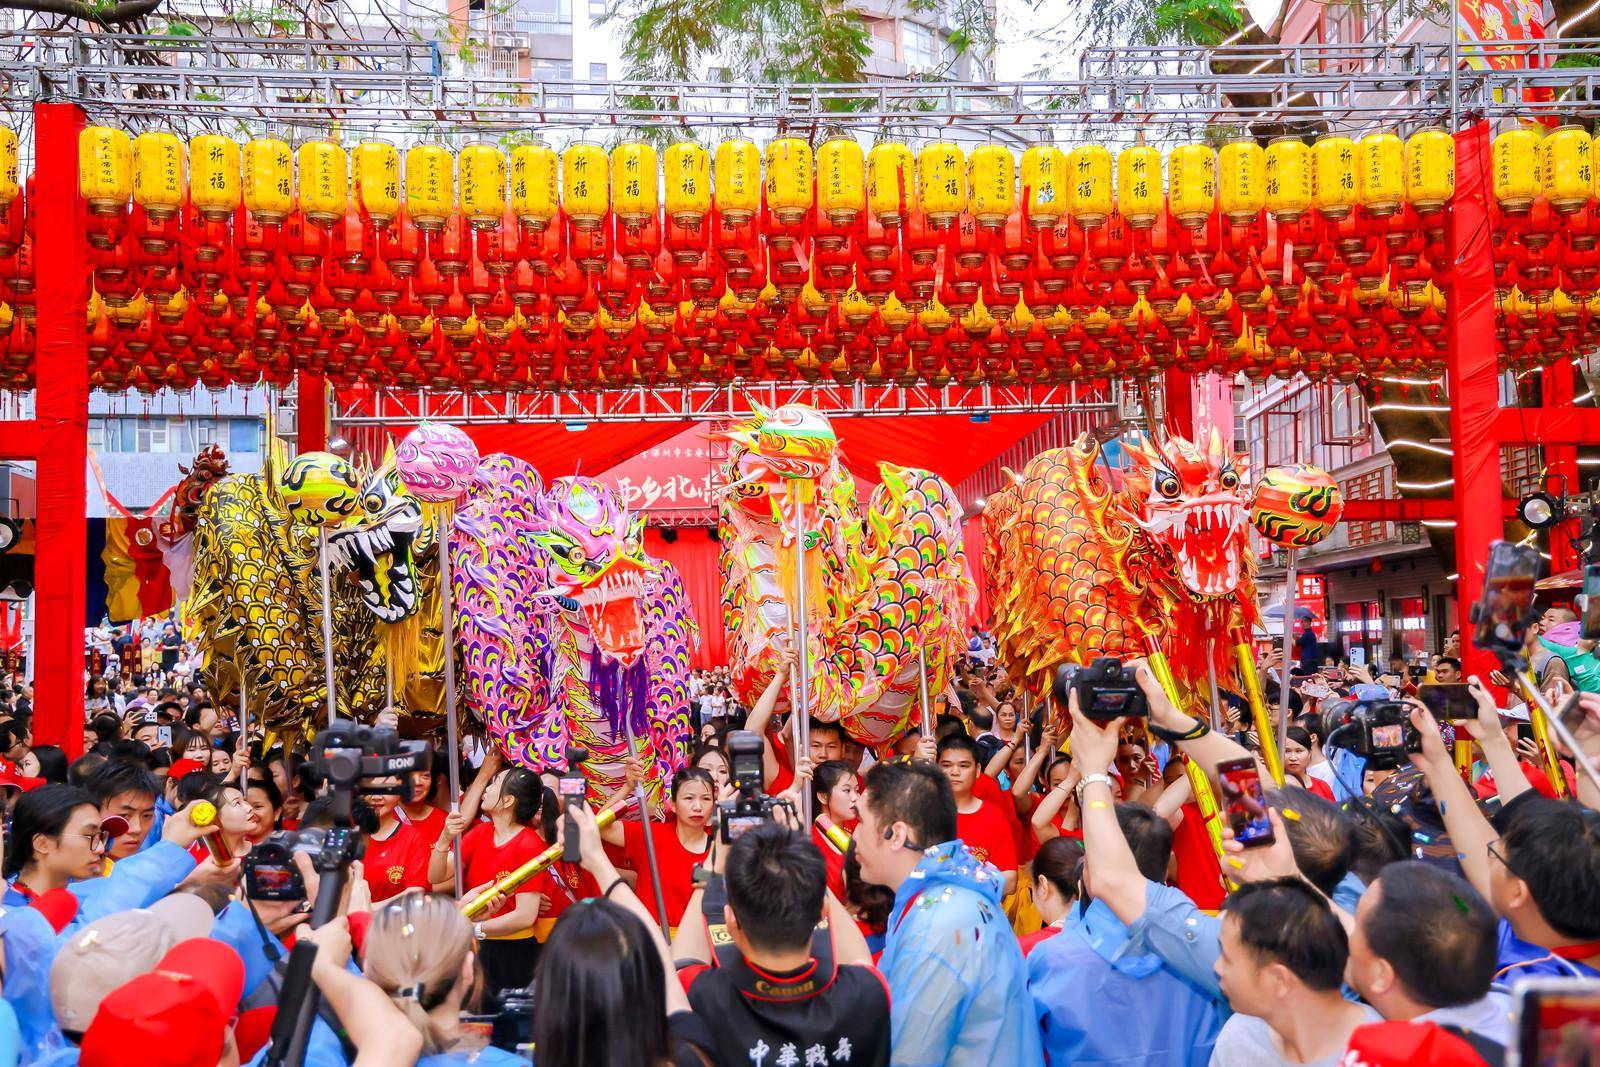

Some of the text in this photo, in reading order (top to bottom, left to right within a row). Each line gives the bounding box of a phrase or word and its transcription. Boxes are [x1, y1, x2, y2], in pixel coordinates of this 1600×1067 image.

[6, 140, 18, 185] 祈福
[210, 146, 225, 190] 祈福
[277, 152, 290, 196] 祈福
[385, 156, 397, 200] 祈福
[515, 156, 526, 198] 祈福
[575, 156, 588, 198] 祈福
[627, 156, 640, 197] 祈福
[682, 153, 696, 195] 祈福
[944, 155, 958, 196] 祈福
[1078, 157, 1091, 198] 祈福
[1133, 157, 1148, 199] 祈福
[1203, 157, 1213, 198] 祈福
[1266, 155, 1280, 196] 祈福
[1340, 148, 1353, 190] 祈福
[1578, 141, 1591, 183] 祈福
[755, 980, 814, 996] Canon
